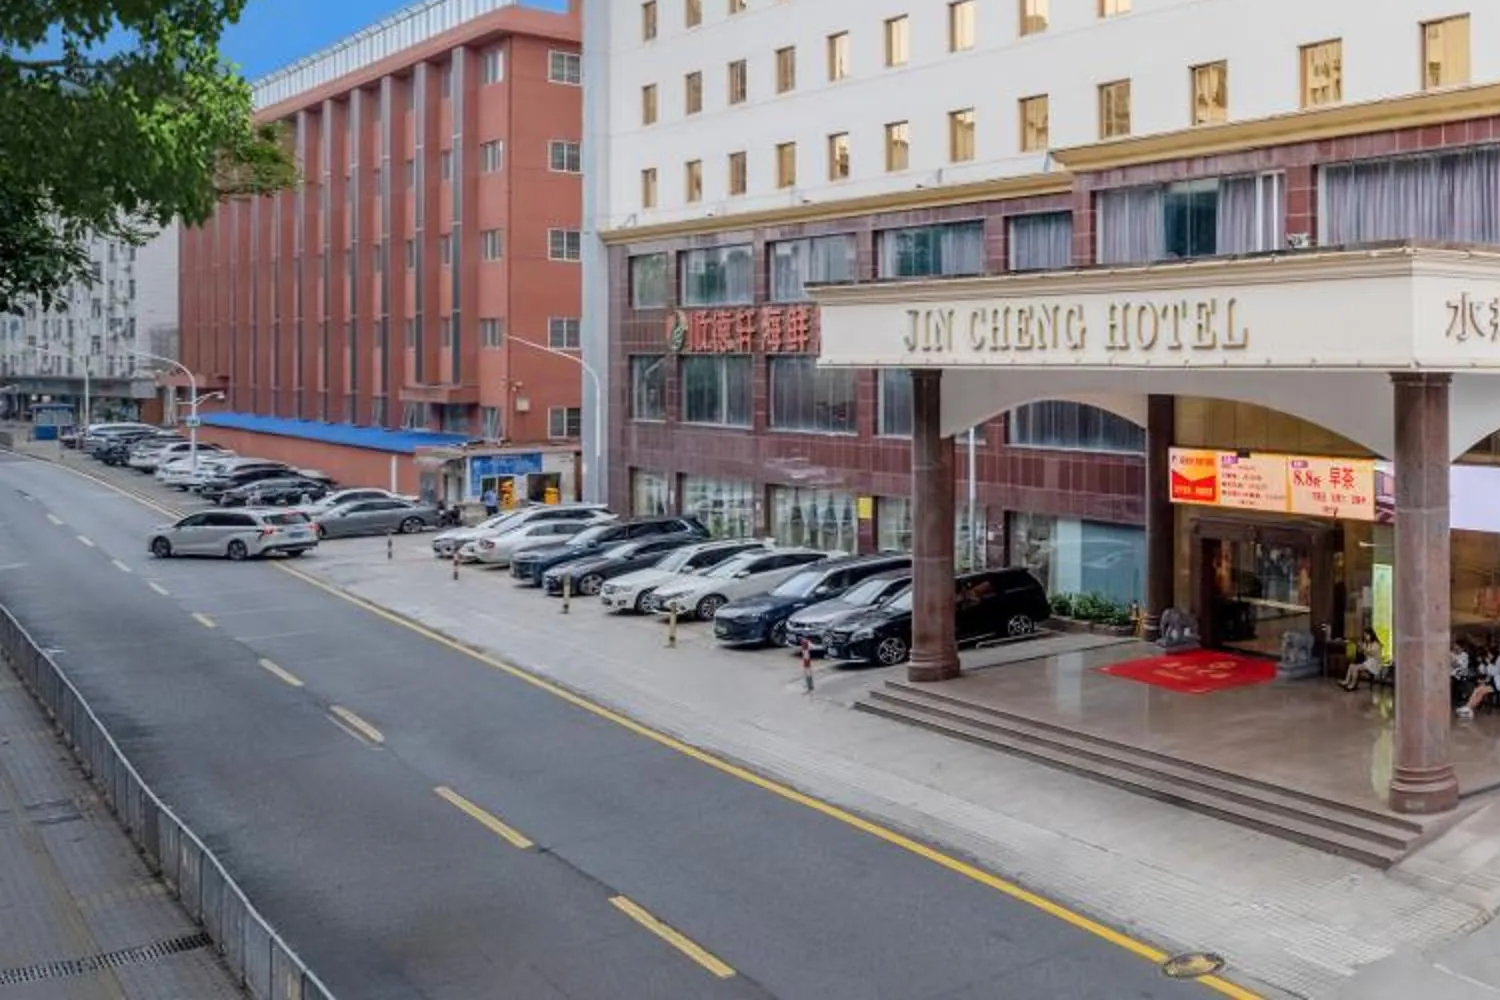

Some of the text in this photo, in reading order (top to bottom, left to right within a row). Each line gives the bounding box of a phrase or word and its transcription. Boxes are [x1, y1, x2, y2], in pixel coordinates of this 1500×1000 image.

[902, 298, 1250, 354] JIN CHENG HOTEL
[1328, 467, 1356, 489] 早茶
